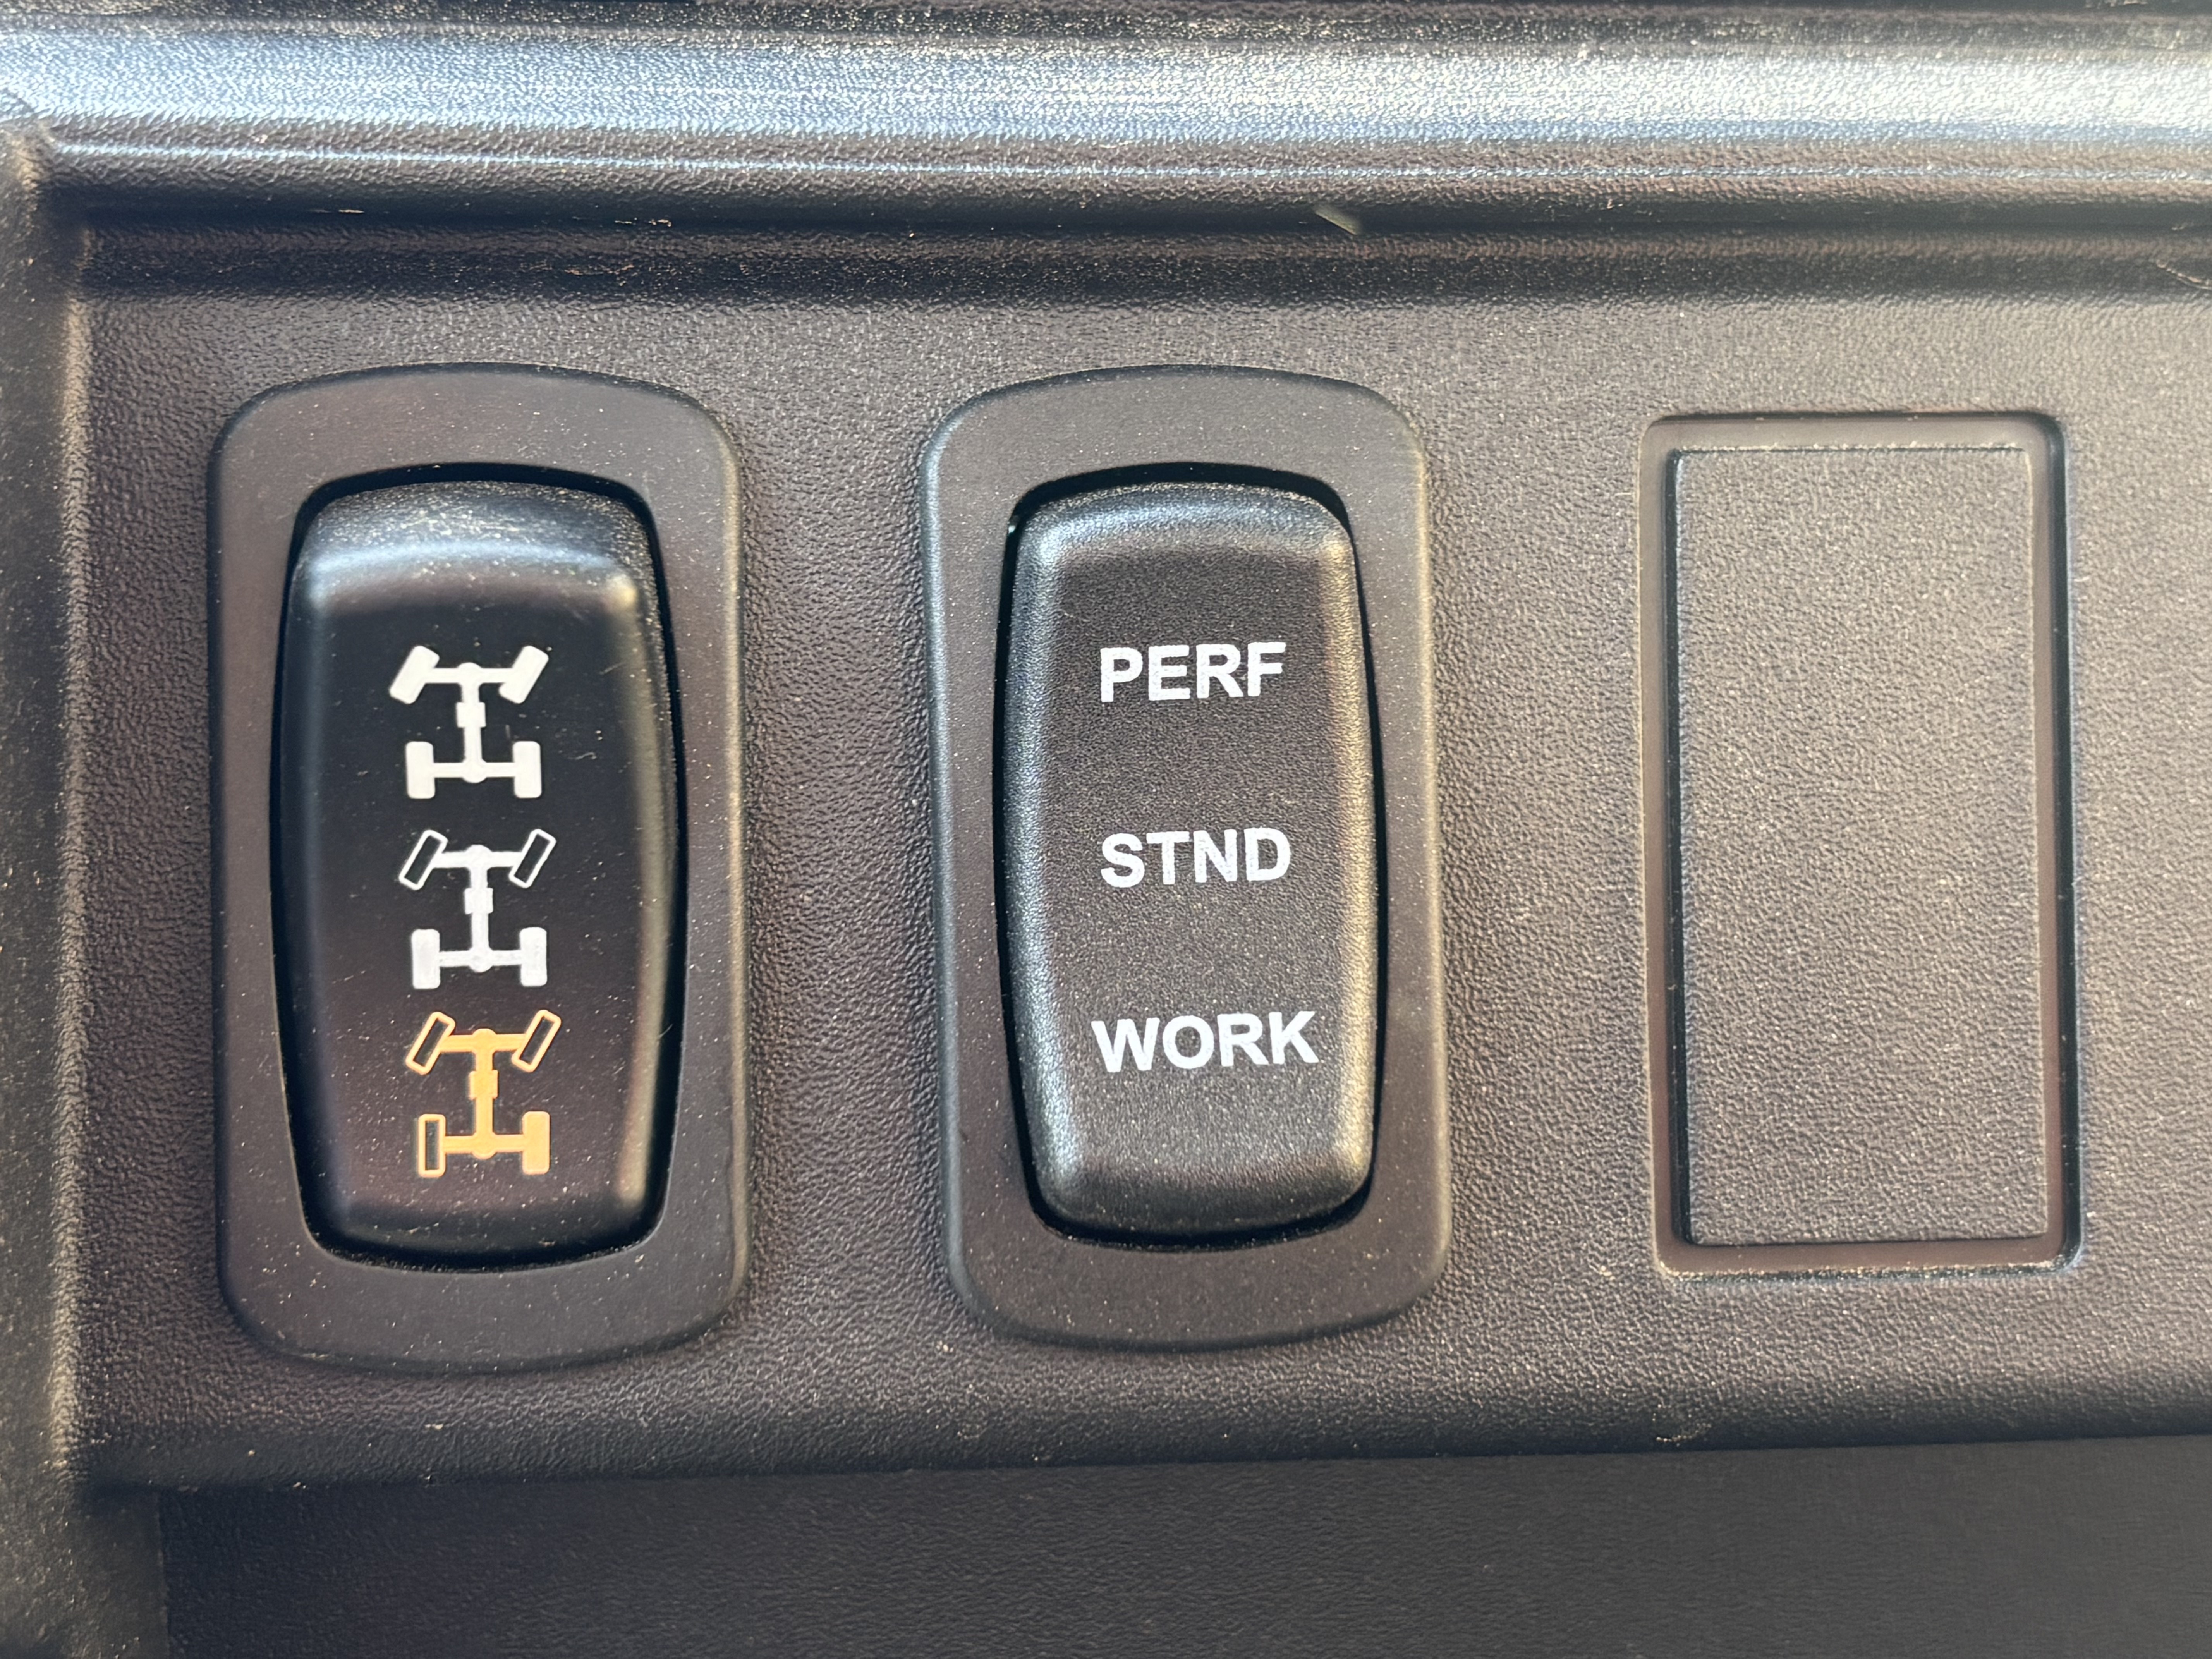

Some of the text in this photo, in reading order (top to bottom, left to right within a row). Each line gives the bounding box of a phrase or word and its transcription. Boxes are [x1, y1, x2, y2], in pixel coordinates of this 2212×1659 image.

[1100, 641, 1287, 703] PERF
[1100, 825, 1293, 888] STND
[1090, 1010, 1320, 1073] WORK
